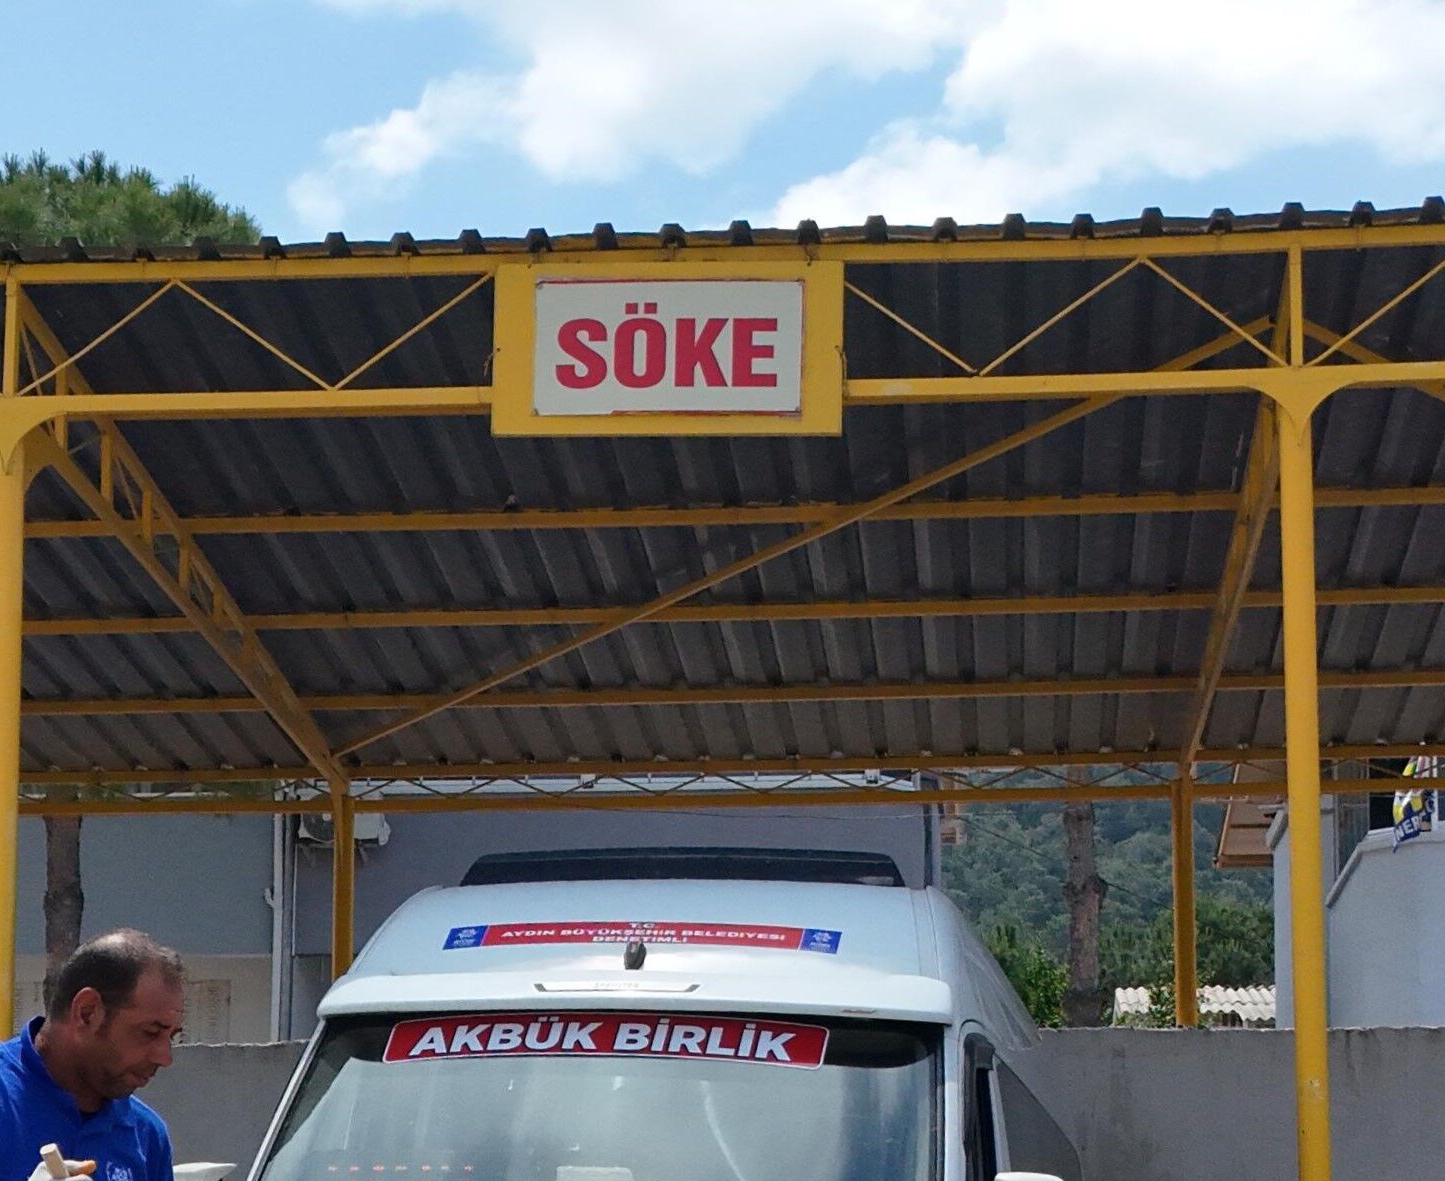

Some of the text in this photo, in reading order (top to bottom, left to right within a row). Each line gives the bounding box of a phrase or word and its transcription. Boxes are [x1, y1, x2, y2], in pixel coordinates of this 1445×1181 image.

[555, 302, 778, 389] SÖKE
[500, 928, 555, 938] AYDIN
[408, 1016, 796, 1062] AKBÜK BİRLİK
